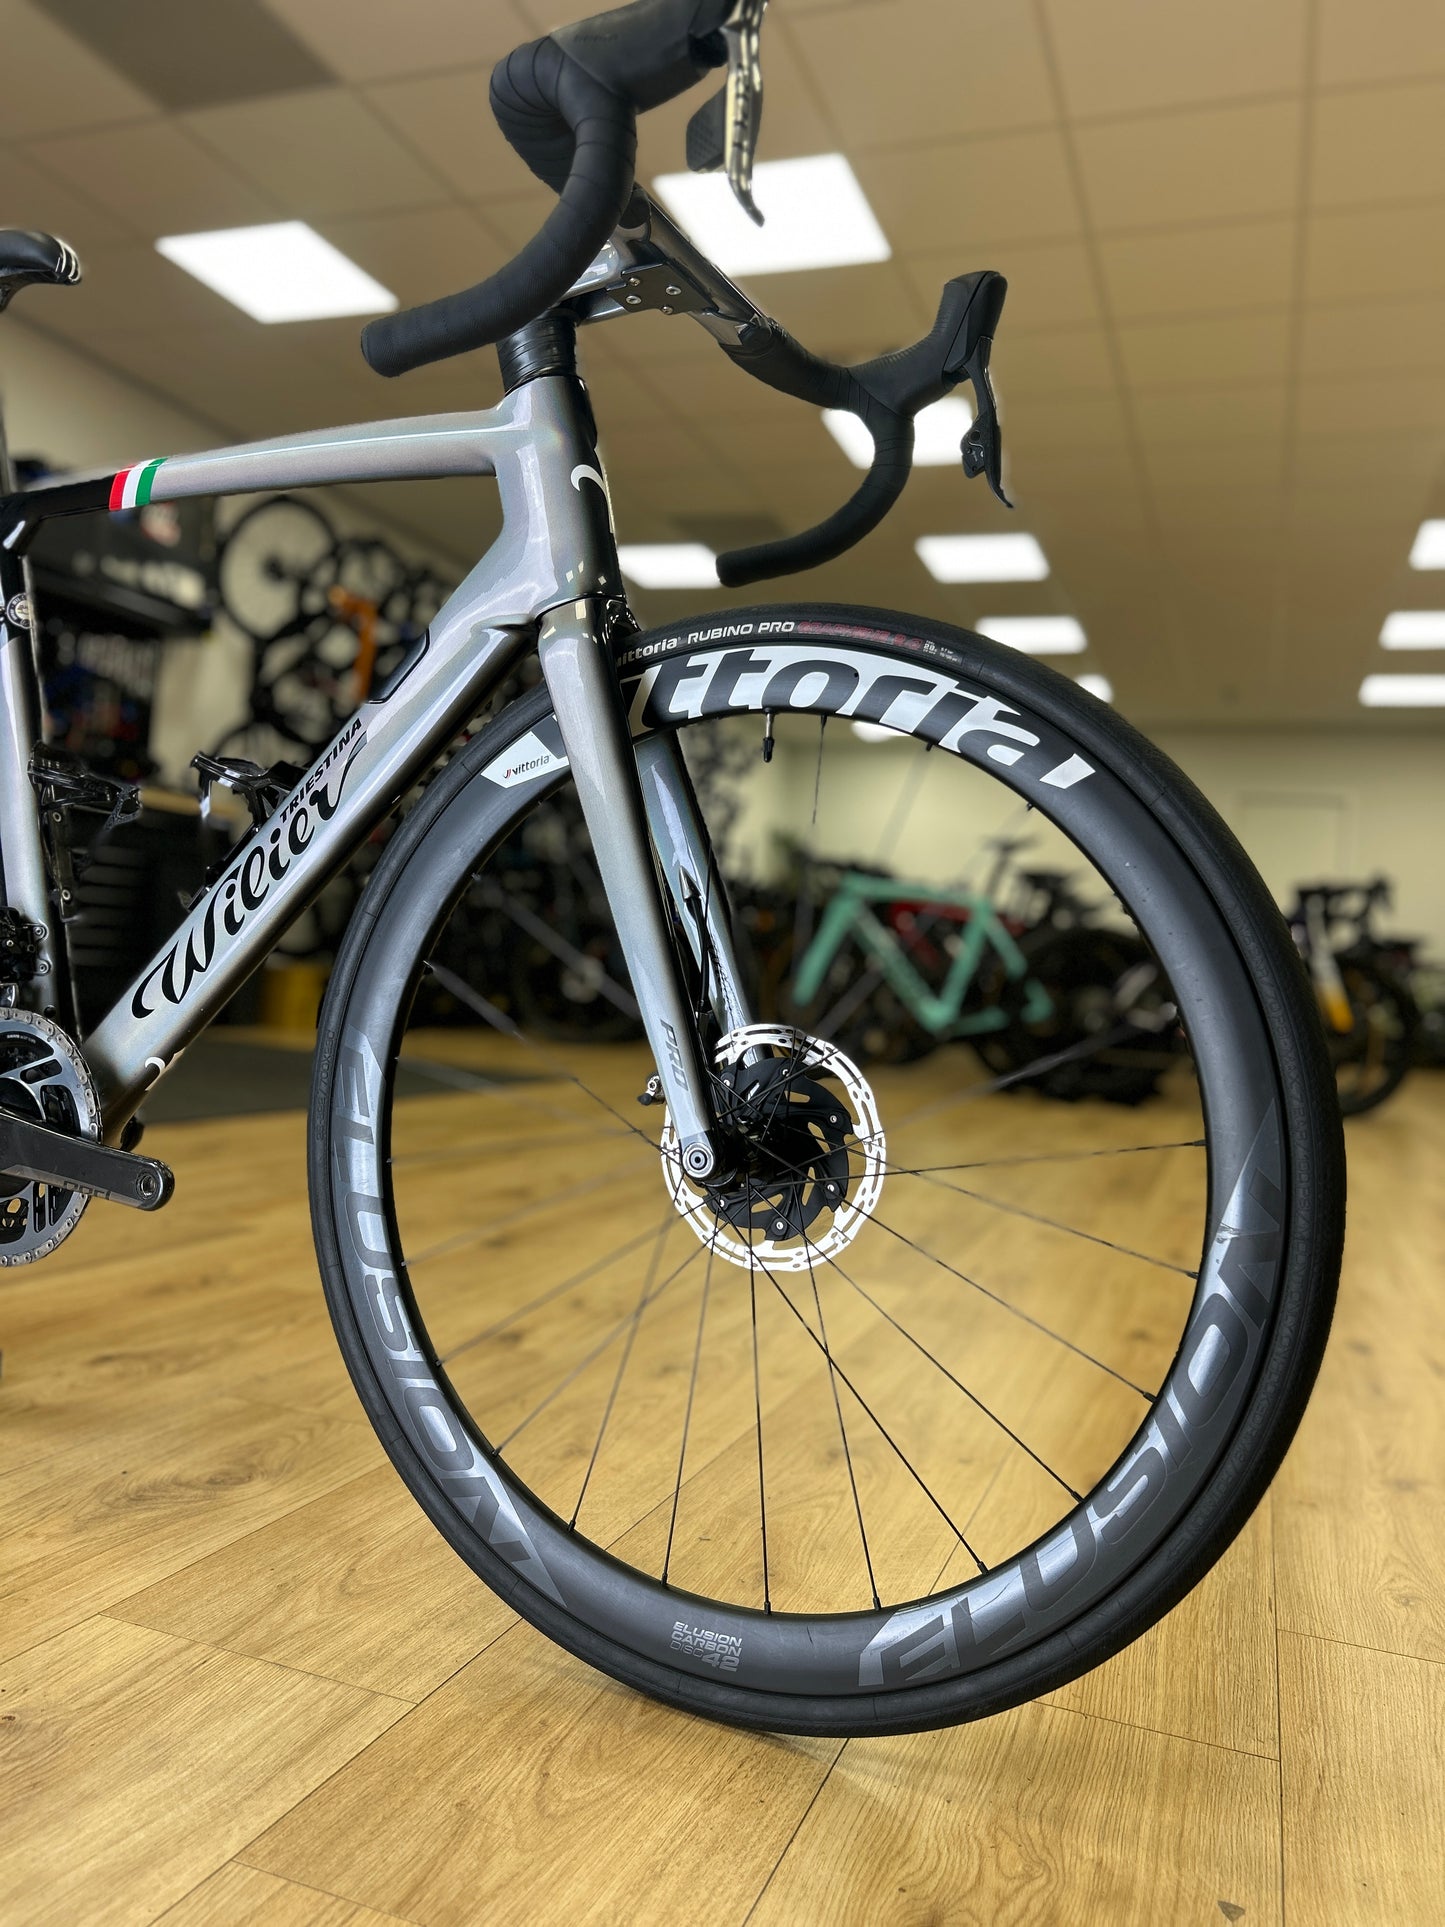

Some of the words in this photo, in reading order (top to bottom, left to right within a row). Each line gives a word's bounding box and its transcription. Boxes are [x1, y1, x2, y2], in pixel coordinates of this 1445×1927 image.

[688, 623, 753, 645] RUBINO
[758, 621, 795, 634] PRO
[279, 718, 362, 823] TRIESTINA
[512, 754, 552, 776] vittoria
[131, 731, 367, 1019] Wilier
[333, 1046, 532, 1566] ELUSION
[878, 1167, 1282, 1687] ELUSION
[671, 1630, 742, 1657] CARBON
[672, 1621, 742, 1647] ELUSION
[670, 1640, 704, 1658] DISC
[701, 1652, 740, 1672] 42
